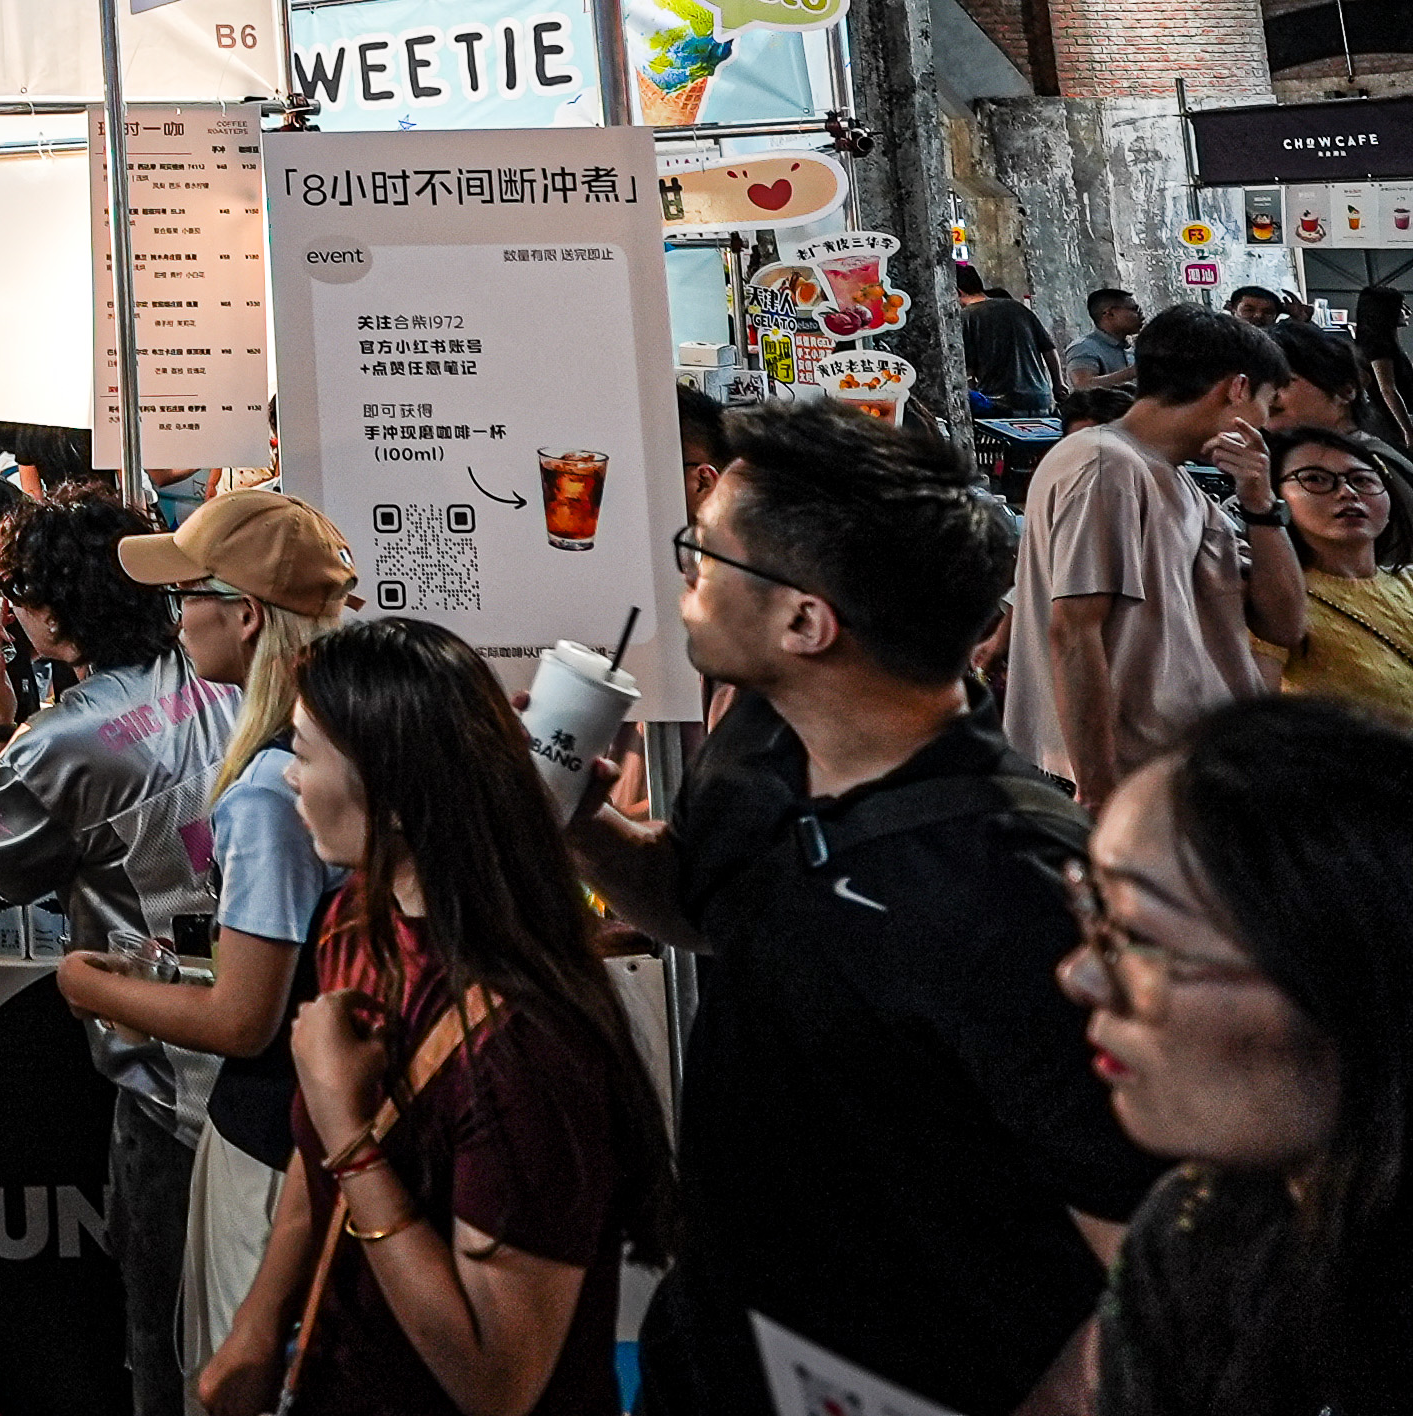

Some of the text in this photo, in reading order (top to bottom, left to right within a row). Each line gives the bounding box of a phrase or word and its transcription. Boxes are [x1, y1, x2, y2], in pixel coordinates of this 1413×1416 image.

[216, 24, 258, 50] B6
[284, 167, 638, 207] 「8小时不间断冲煮」
[1188, 229, 1205, 241] F3
[306, 248, 365, 264] event
[503, 247, 614, 262] 数量有限 送完即止
[753, 314, 796, 331] GELATO
[358, 338, 482, 355] 官方小红书账号
[360, 360, 478, 376] +点赞任意笔记
[363, 403, 433, 419] 即可获得
[364, 424, 507, 441] 手冲现磨咖啡一杯
